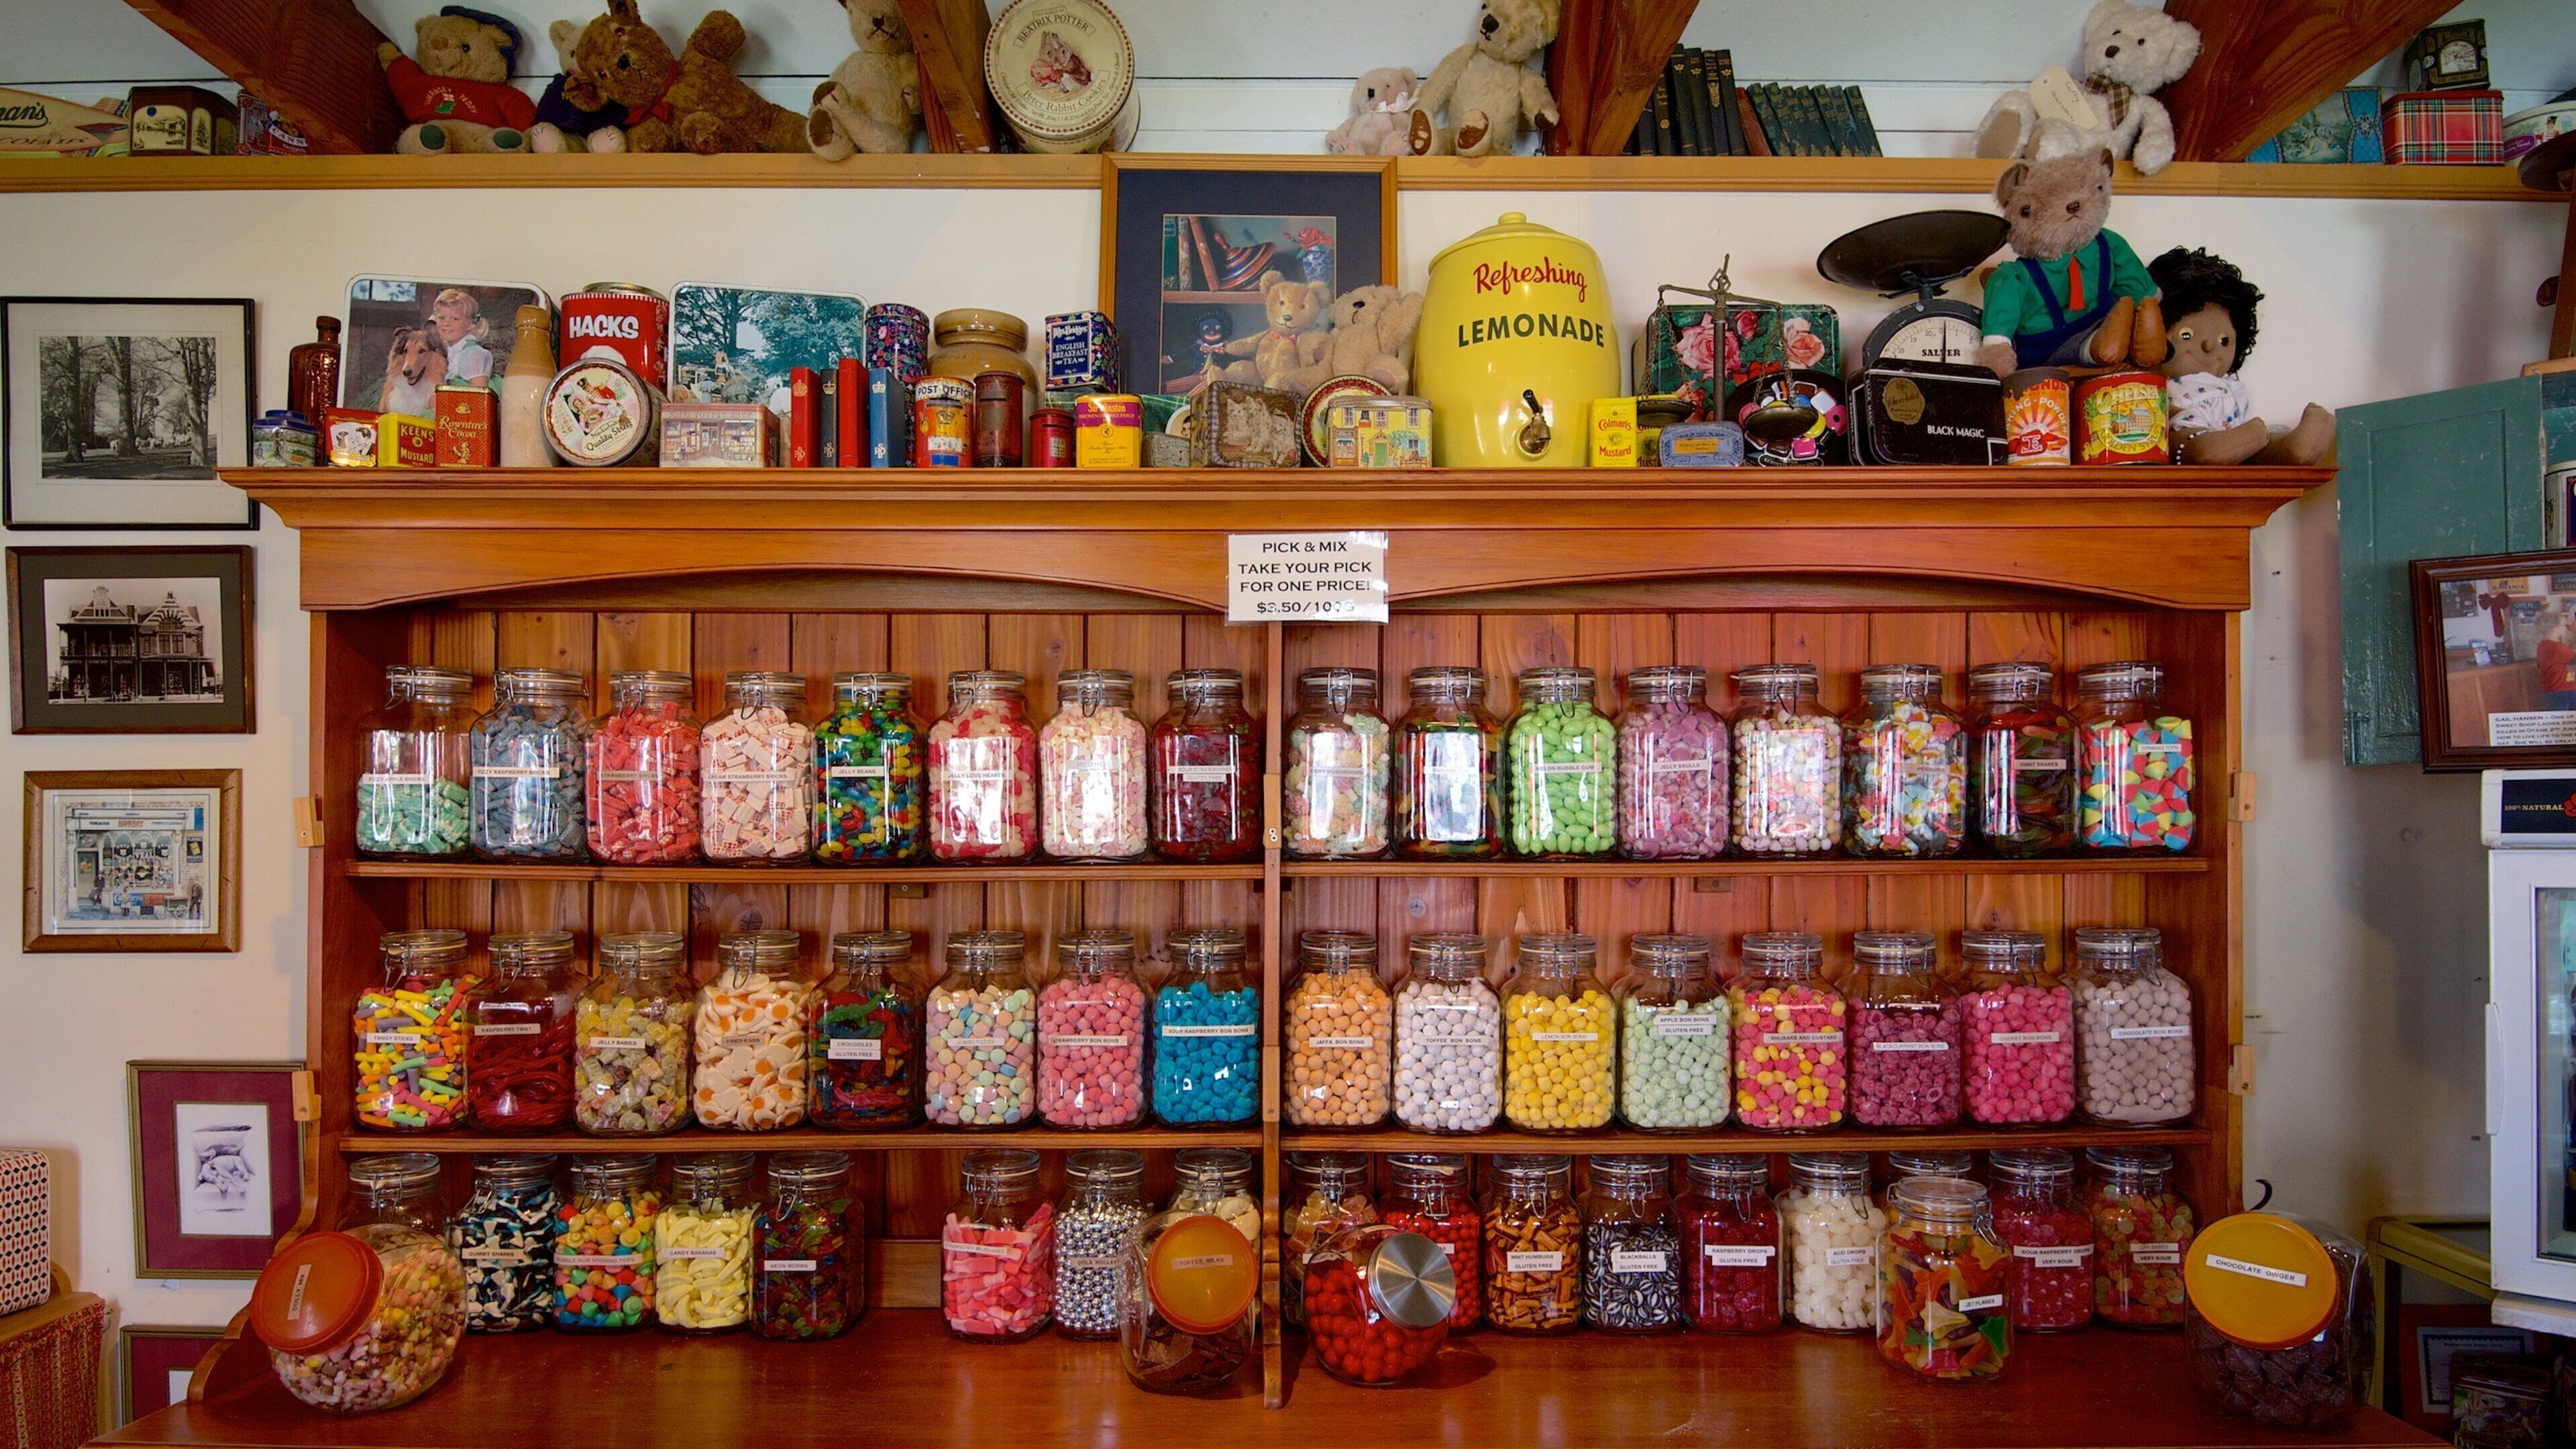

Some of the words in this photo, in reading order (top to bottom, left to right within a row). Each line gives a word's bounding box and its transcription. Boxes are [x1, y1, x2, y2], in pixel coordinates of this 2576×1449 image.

[1018, 14, 1051, 42] BEATRIX
[1055, 14, 1089, 32] POTTER
[1023, 89, 1043, 108] Peter
[1046, 101, 1076, 112] Rabbit
[1078, 78, 1106, 107] Cookies
[459, 93, 478, 114] TEDDY
[1474, 256, 1588, 303] Refreshing
[569, 313, 639, 339] HACKS
[1458, 313, 1604, 348] LEMONADE
[1055, 341, 1085, 352] ENGLISH
[1921, 349, 1961, 357] SALTER
[1053, 349, 1088, 359] BREAKFAST
[1063, 357, 1078, 366] TEA
[918, 386, 938, 396] POST
[943, 386, 972, 400] OFFICE
[1088, 403, 1097, 413] Sir
[2039, 396, 2068, 433] POWDER
[438, 416, 488, 432] Rowntree's
[1598, 419, 1632, 431] Colman's
[448, 428, 476, 438] Cocoa
[1927, 425, 1954, 435] BLACK
[1955, 427, 1985, 439] MAGIC
[2101, 429, 2137, 452] GOLDEN
[2139, 425, 2160, 450] SYRUP
[586, 433, 613, 451] Quality
[400, 447, 434, 464] MUSTARD
[1599, 445, 1631, 458] Mustard
[1263, 542, 1300, 553] PICK
[1304, 542, 1315, 552] &
[1320, 541, 1347, 551] MIX
[1238, 564, 1281, 574] TAKE
[1285, 563, 1330, 573] YOUR
[1334, 562, 1372, 572] PICK
[1240, 582, 1273, 592] FOR
[1277, 581, 1312, 592] ONE
[1317, 580, 1370, 591] PRICE!
[975, 1246, 1005, 1254] MILKSHAKES
[2216, 1258, 2262, 1275] CHOCOLATE
[2265, 1270, 2296, 1281] GINGER
[292, 1287, 301, 1311] DOLLY
[1975, 1299, 1996, 1307] PLANES
